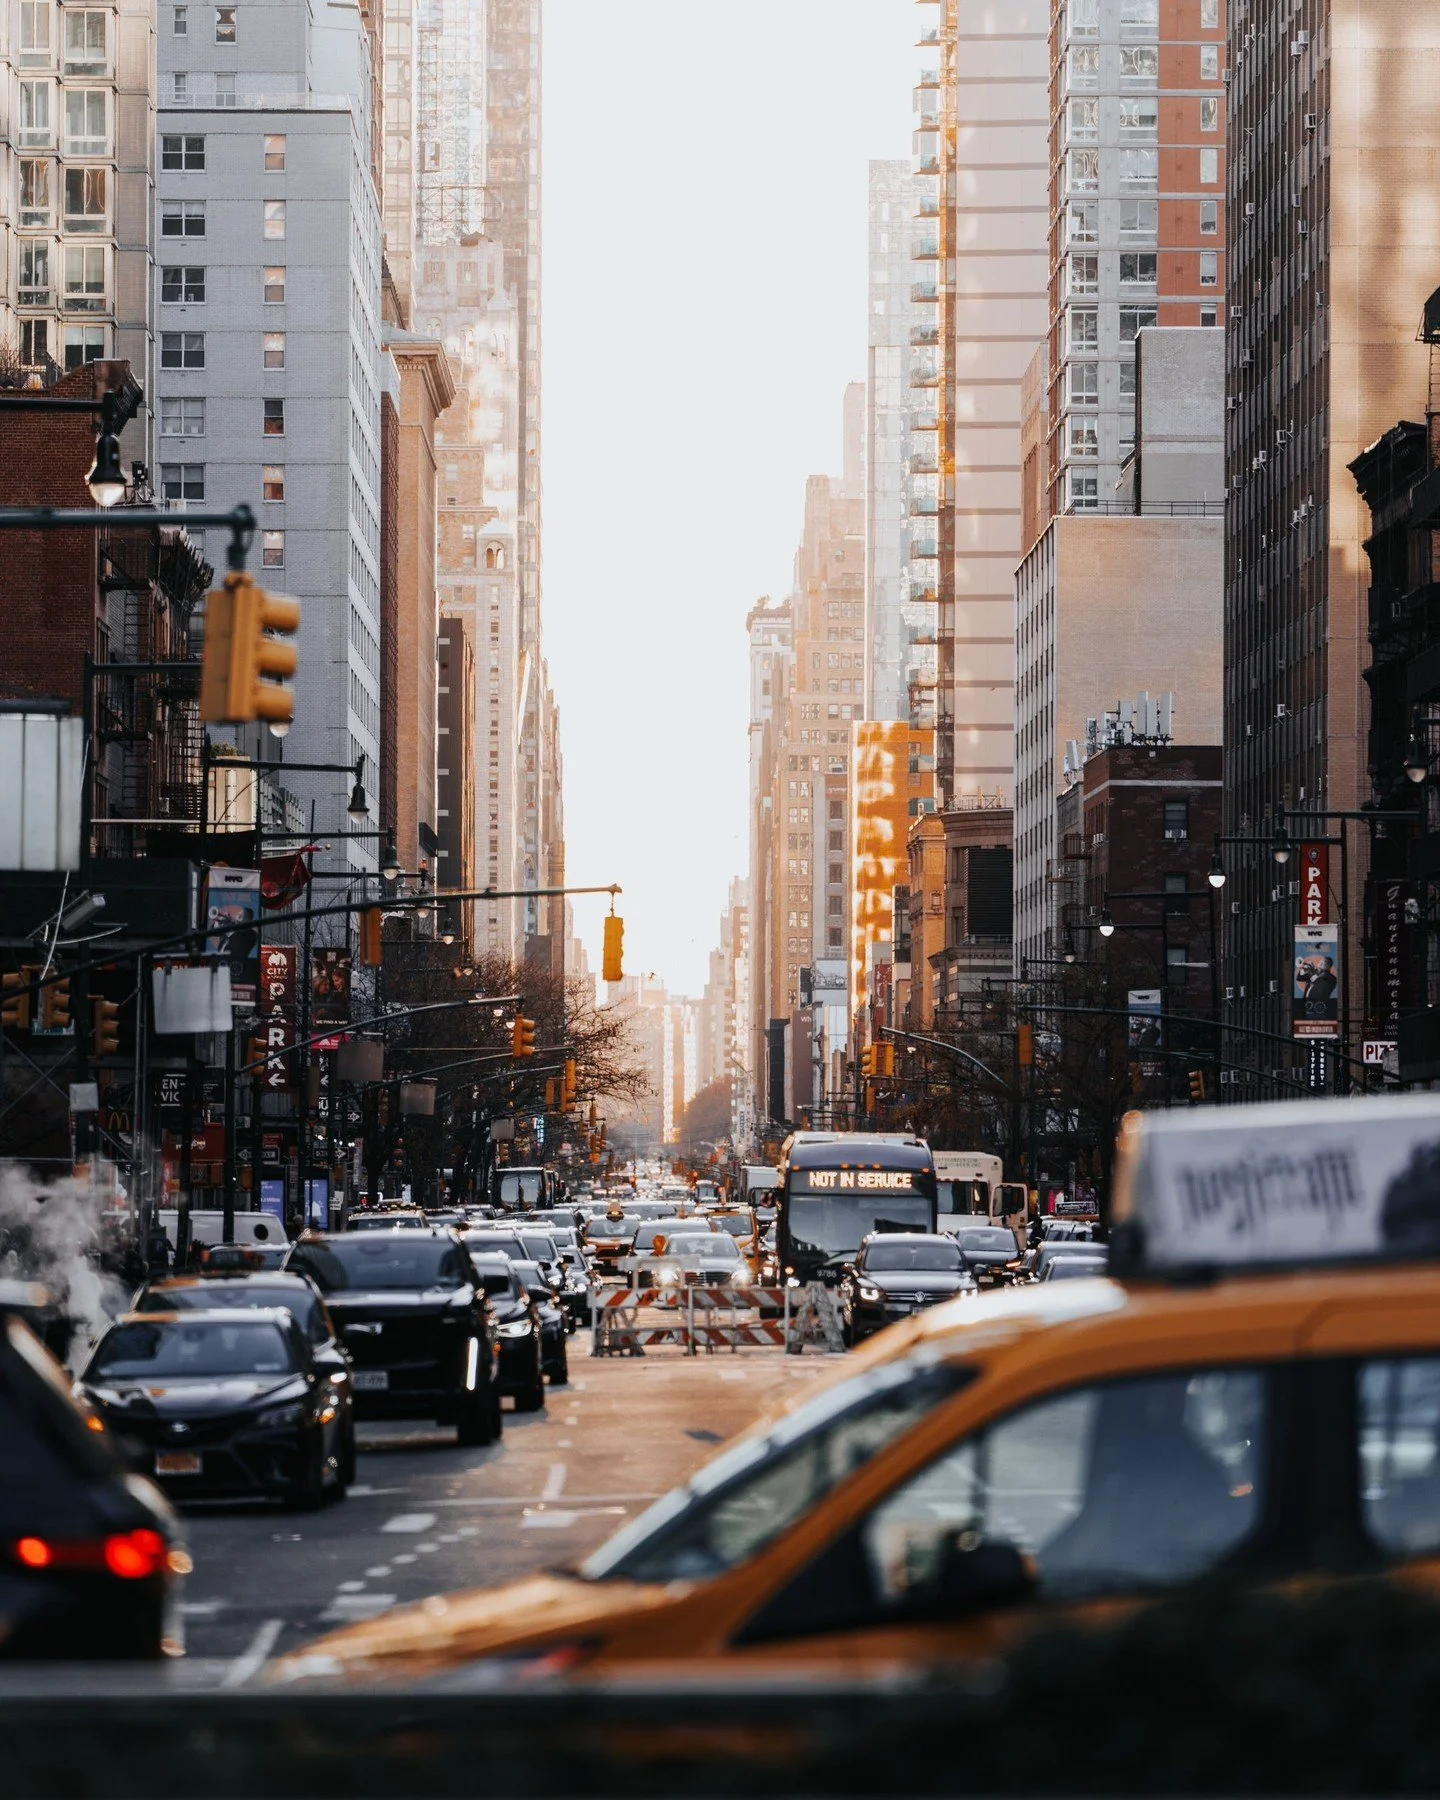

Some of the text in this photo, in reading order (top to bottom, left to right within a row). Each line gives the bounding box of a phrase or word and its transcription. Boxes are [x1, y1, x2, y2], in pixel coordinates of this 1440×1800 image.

[1306, 867, 1321, 926] PARK
[810, 1172, 912, 1188] NOT IN SERVICE
